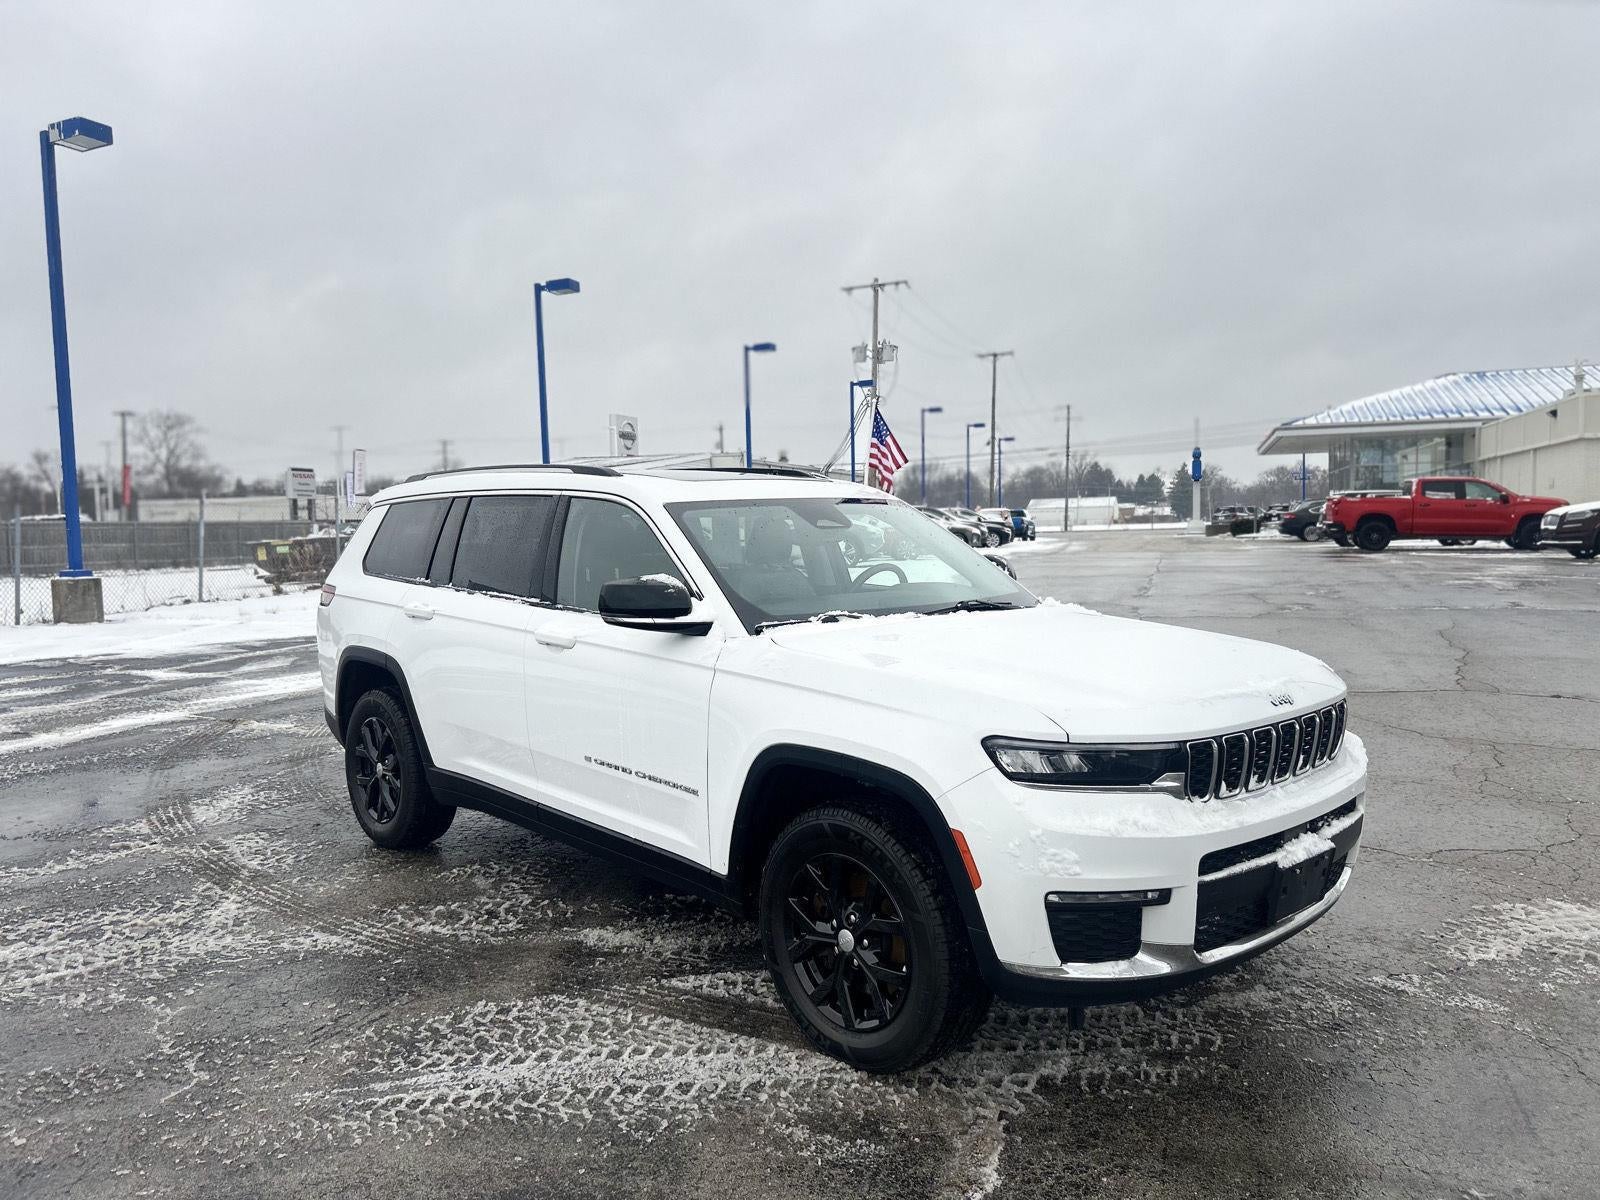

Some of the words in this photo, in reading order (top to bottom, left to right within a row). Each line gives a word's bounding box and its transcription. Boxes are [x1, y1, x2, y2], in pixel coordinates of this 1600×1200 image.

[1270, 693, 1294, 707] Jeep
[594, 758, 632, 775] GRAND
[634, 770, 700, 797] CHEROKEE
